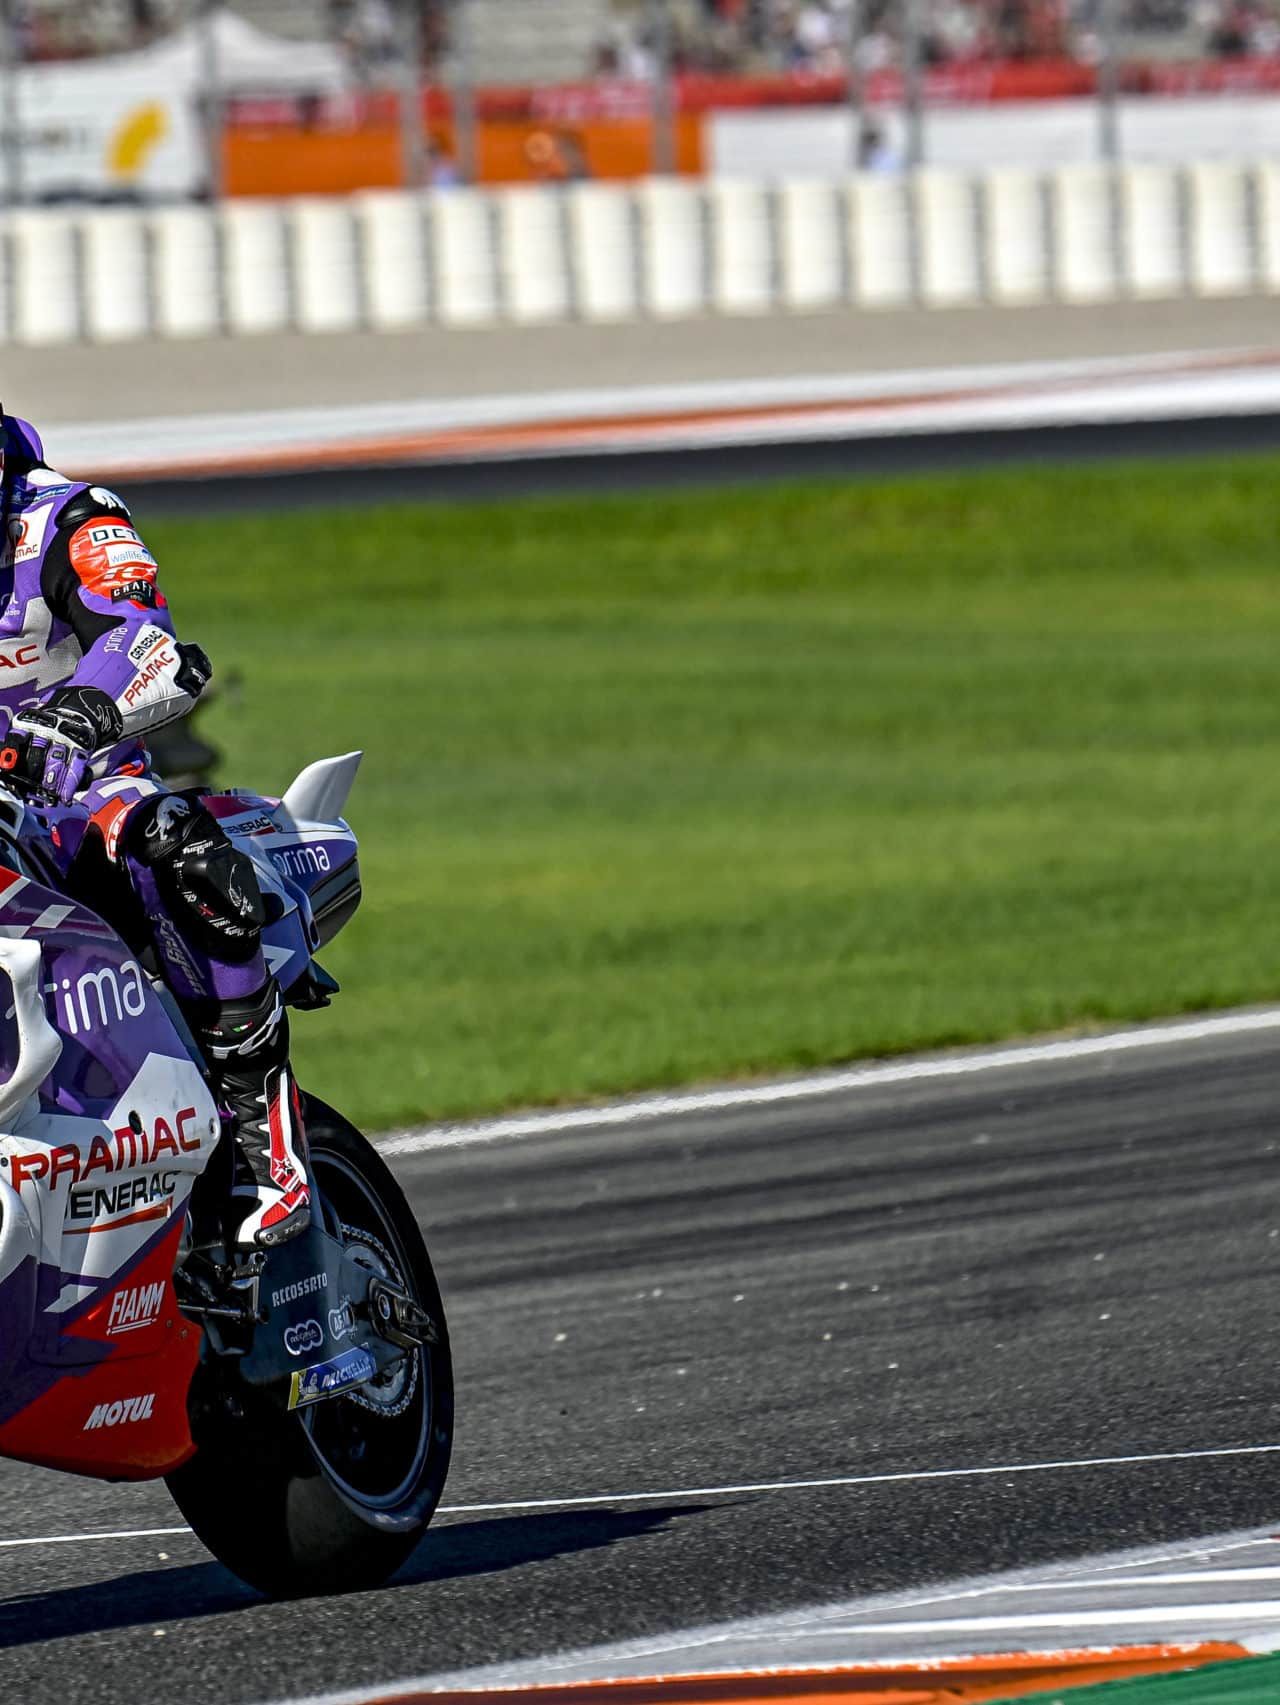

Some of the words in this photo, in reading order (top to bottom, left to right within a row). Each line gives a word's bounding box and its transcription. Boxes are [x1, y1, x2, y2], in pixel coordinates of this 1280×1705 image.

[92, 528, 137, 541] OCT
[130, 630, 163, 660] GENERAC
[124, 651, 175, 706] PRAMAC
[10, 1107, 201, 1193] PRAMAC
[66, 1170, 181, 1219] ENERAC
[108, 1280, 166, 1327] FIAMM
[83, 1393, 156, 1431] MOTUL
